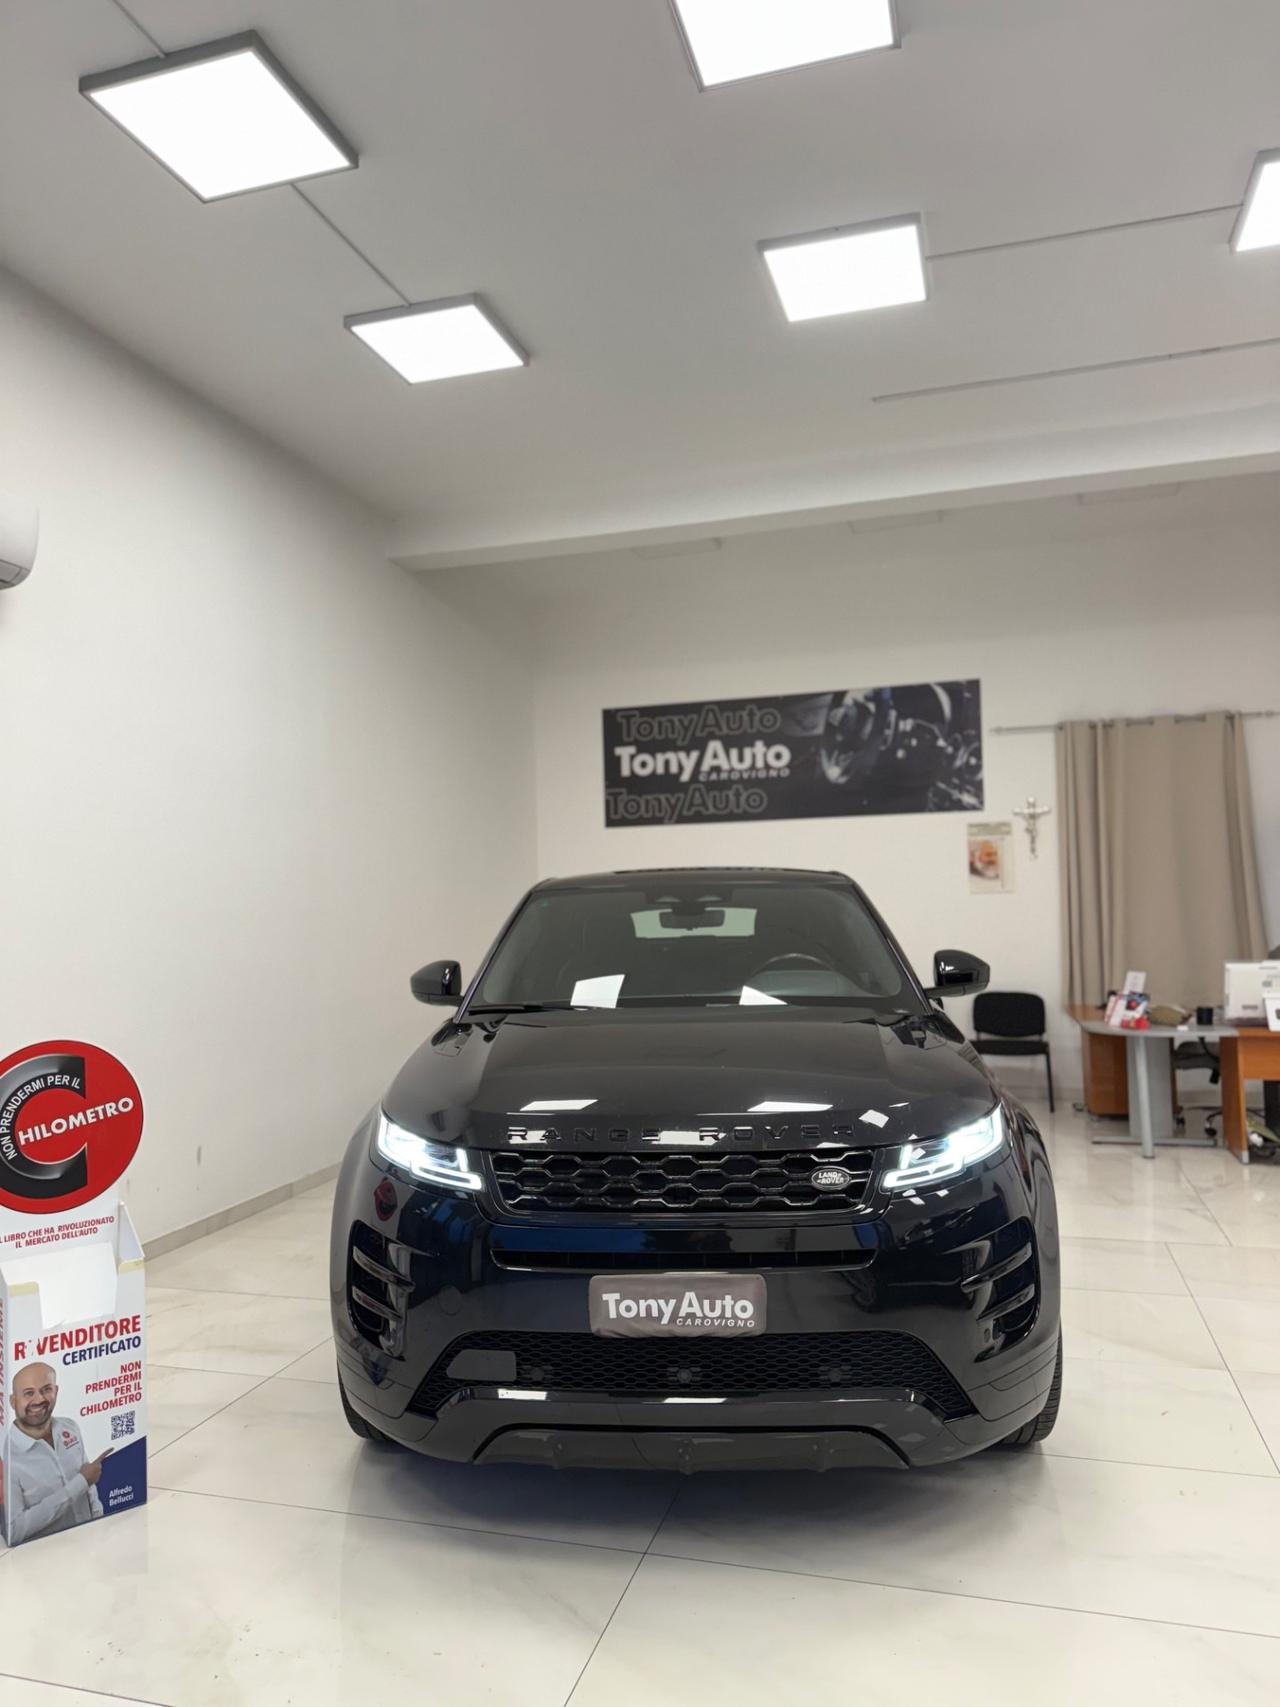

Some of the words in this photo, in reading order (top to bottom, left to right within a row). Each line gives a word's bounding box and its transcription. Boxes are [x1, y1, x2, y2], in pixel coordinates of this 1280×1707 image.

[698, 768, 791, 781] CAROVIGNO
[47, 1075, 70, 1086] PER
[71, 1077, 80, 1089] IL
[0, 1078, 45, 1133] PRENDERMI
[507, 1126, 661, 1142] RANGE
[699, 1125, 854, 1141] ROVER
[1, 1136, 18, 1160] NON
[818, 1171, 838, 1179] LAND
[821, 1177, 844, 1185] ROVER
[4, 1232, 26, 1242] LIBRO
[28, 1228, 42, 1238] CHE
[58, 1216, 114, 1232] RIVOLUZIONATO
[25, 1233, 60, 1247] MERCATO
[61, 1227, 98, 1240] DELL'AUTO
[676, 1318, 755, 1328] CAROVIGNO
[14, 1315, 141, 1361] RVENDITORE
[62, 1335, 141, 1365] CERTIFICATO
[120, 1360, 141, 1374] NON
[85, 1371, 141, 1394] PRENDERMI
[114, 1384, 132, 1397] PER
[134, 1381, 142, 1391] IL
[80, 1391, 142, 1416] CHILOMETRO
[109, 1485, 133, 1498] Alfredo
[109, 1493, 134, 1507] Bellucci
